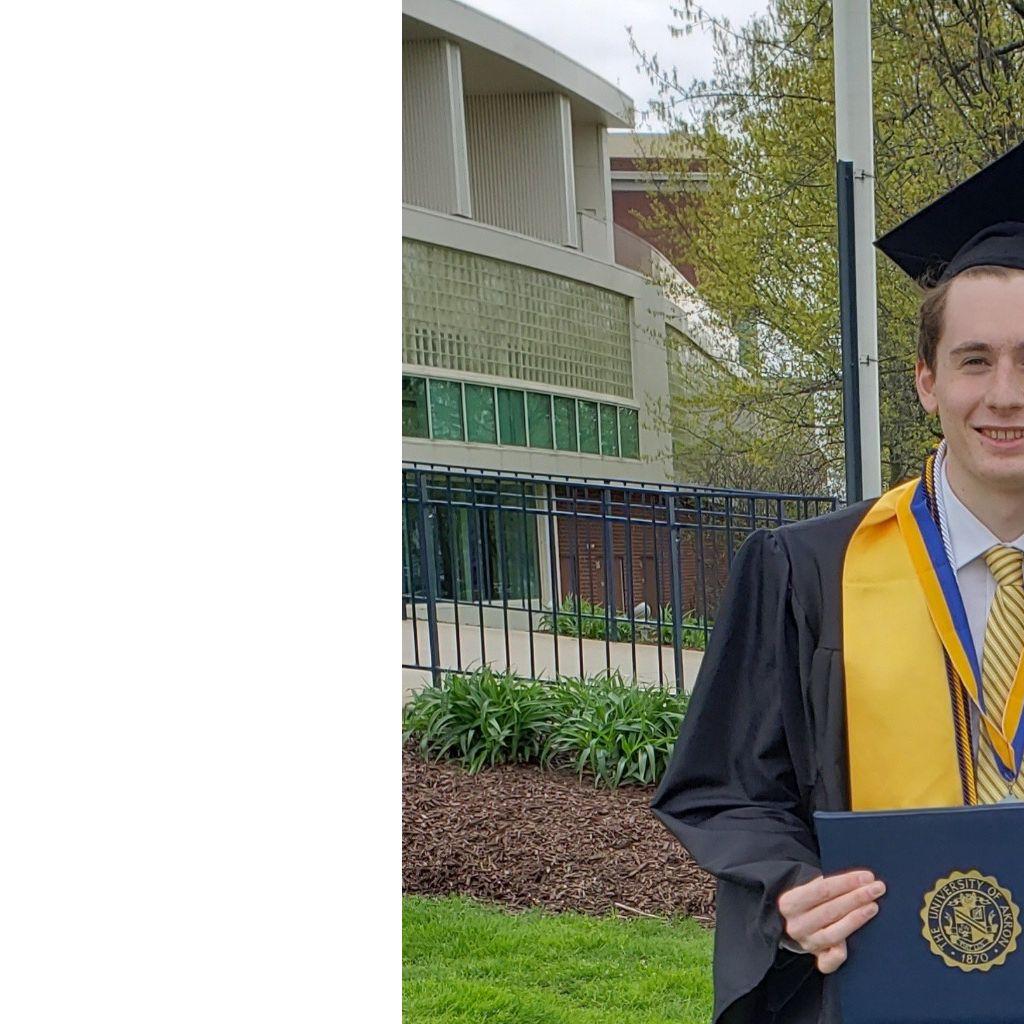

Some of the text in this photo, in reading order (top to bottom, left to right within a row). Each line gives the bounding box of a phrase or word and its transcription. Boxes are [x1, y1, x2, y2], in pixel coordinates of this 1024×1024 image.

[929, 878, 1013, 951] THE UNIVERSITY OF AKRON
[961, 953, 989, 964] 1870
